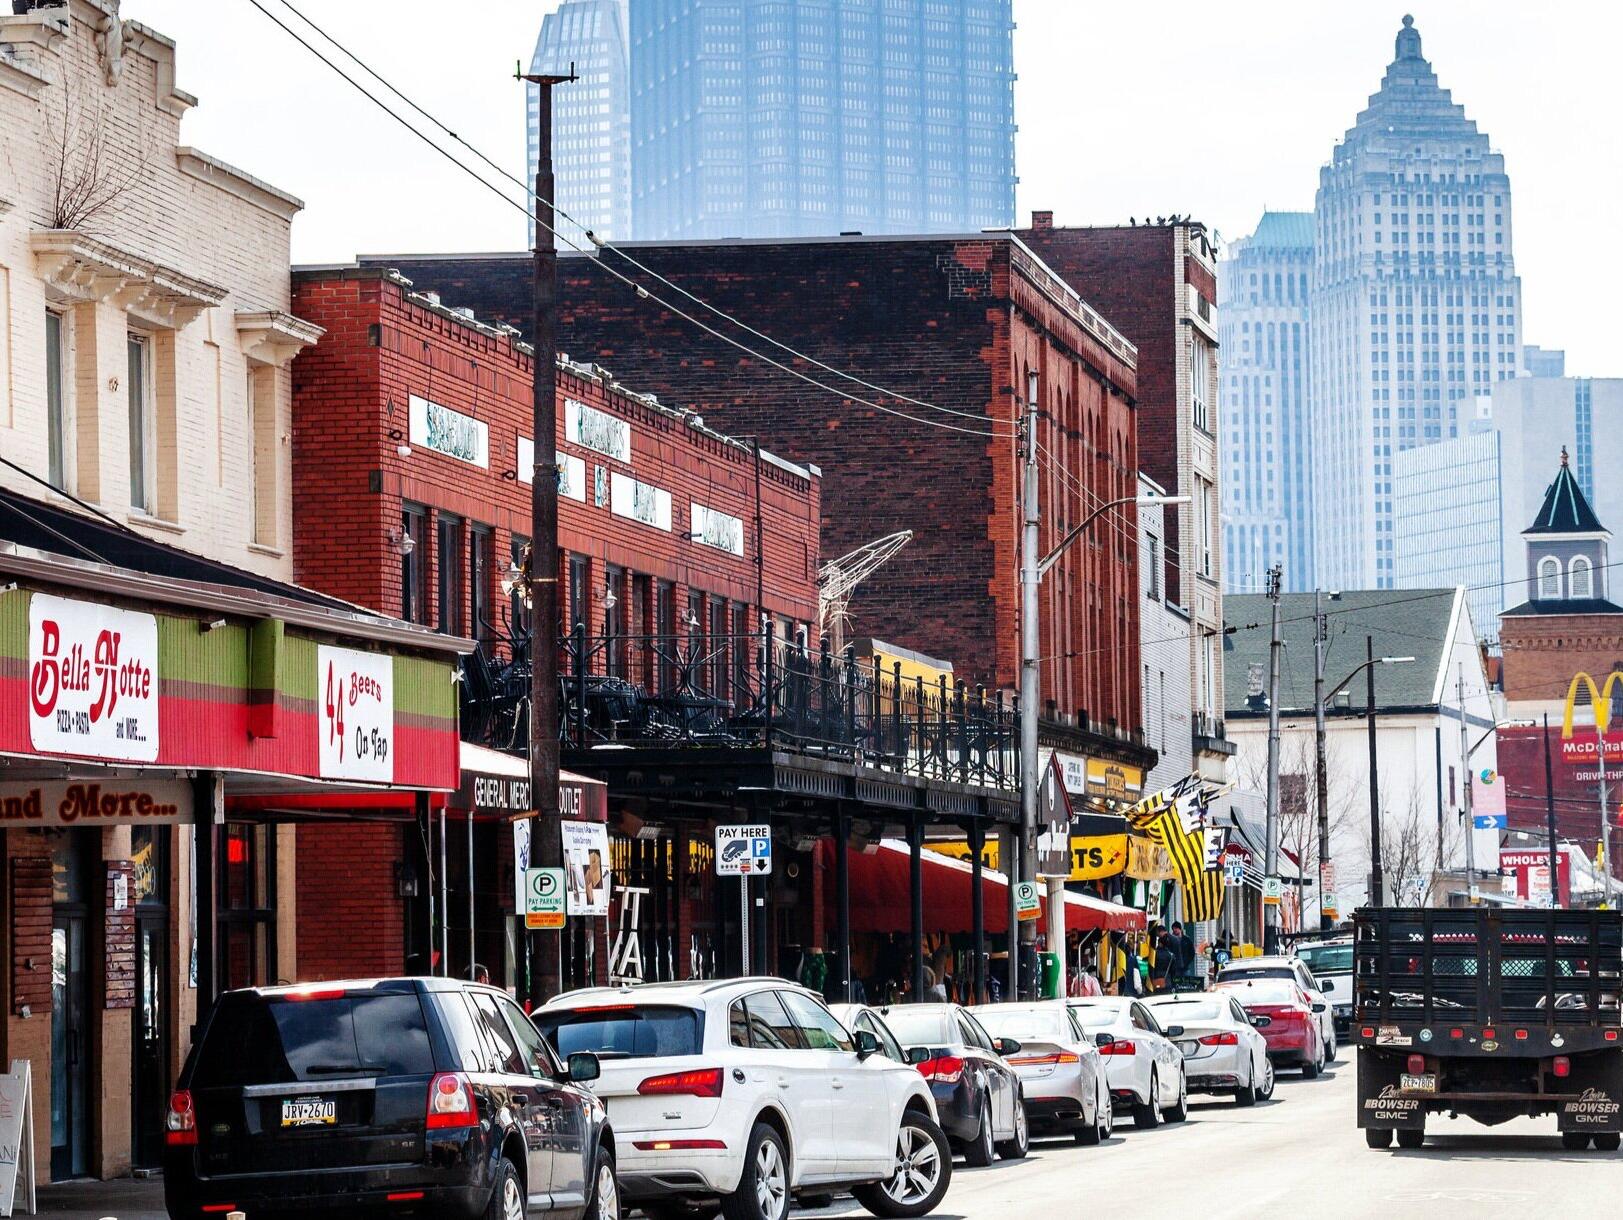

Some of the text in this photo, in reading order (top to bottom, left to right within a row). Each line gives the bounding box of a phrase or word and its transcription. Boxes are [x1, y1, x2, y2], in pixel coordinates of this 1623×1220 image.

[32, 620, 150, 723] Bella Notte
[326, 660, 382, 764] 44 Beers
[57, 709, 90, 735] PIZZA PASTA
[116, 717, 124, 739] and
[356, 726, 387, 763] On Tap
[58, 784, 178, 823] More...
[475, 776, 507, 808] GENERAL
[559, 787, 582, 815] OUTLET
[719, 828, 767, 838] PAY HERE
[755, 840, 767, 857] P
[539, 876, 552, 892] P
[1021, 887, 1030, 897] P
[1370, 1099, 1419, 1110] BOWSER
[1570, 1102, 1620, 1113] BOWSER
[1375, 1111, 1408, 1120] GMC
[1575, 1114, 1609, 1123] GMC
